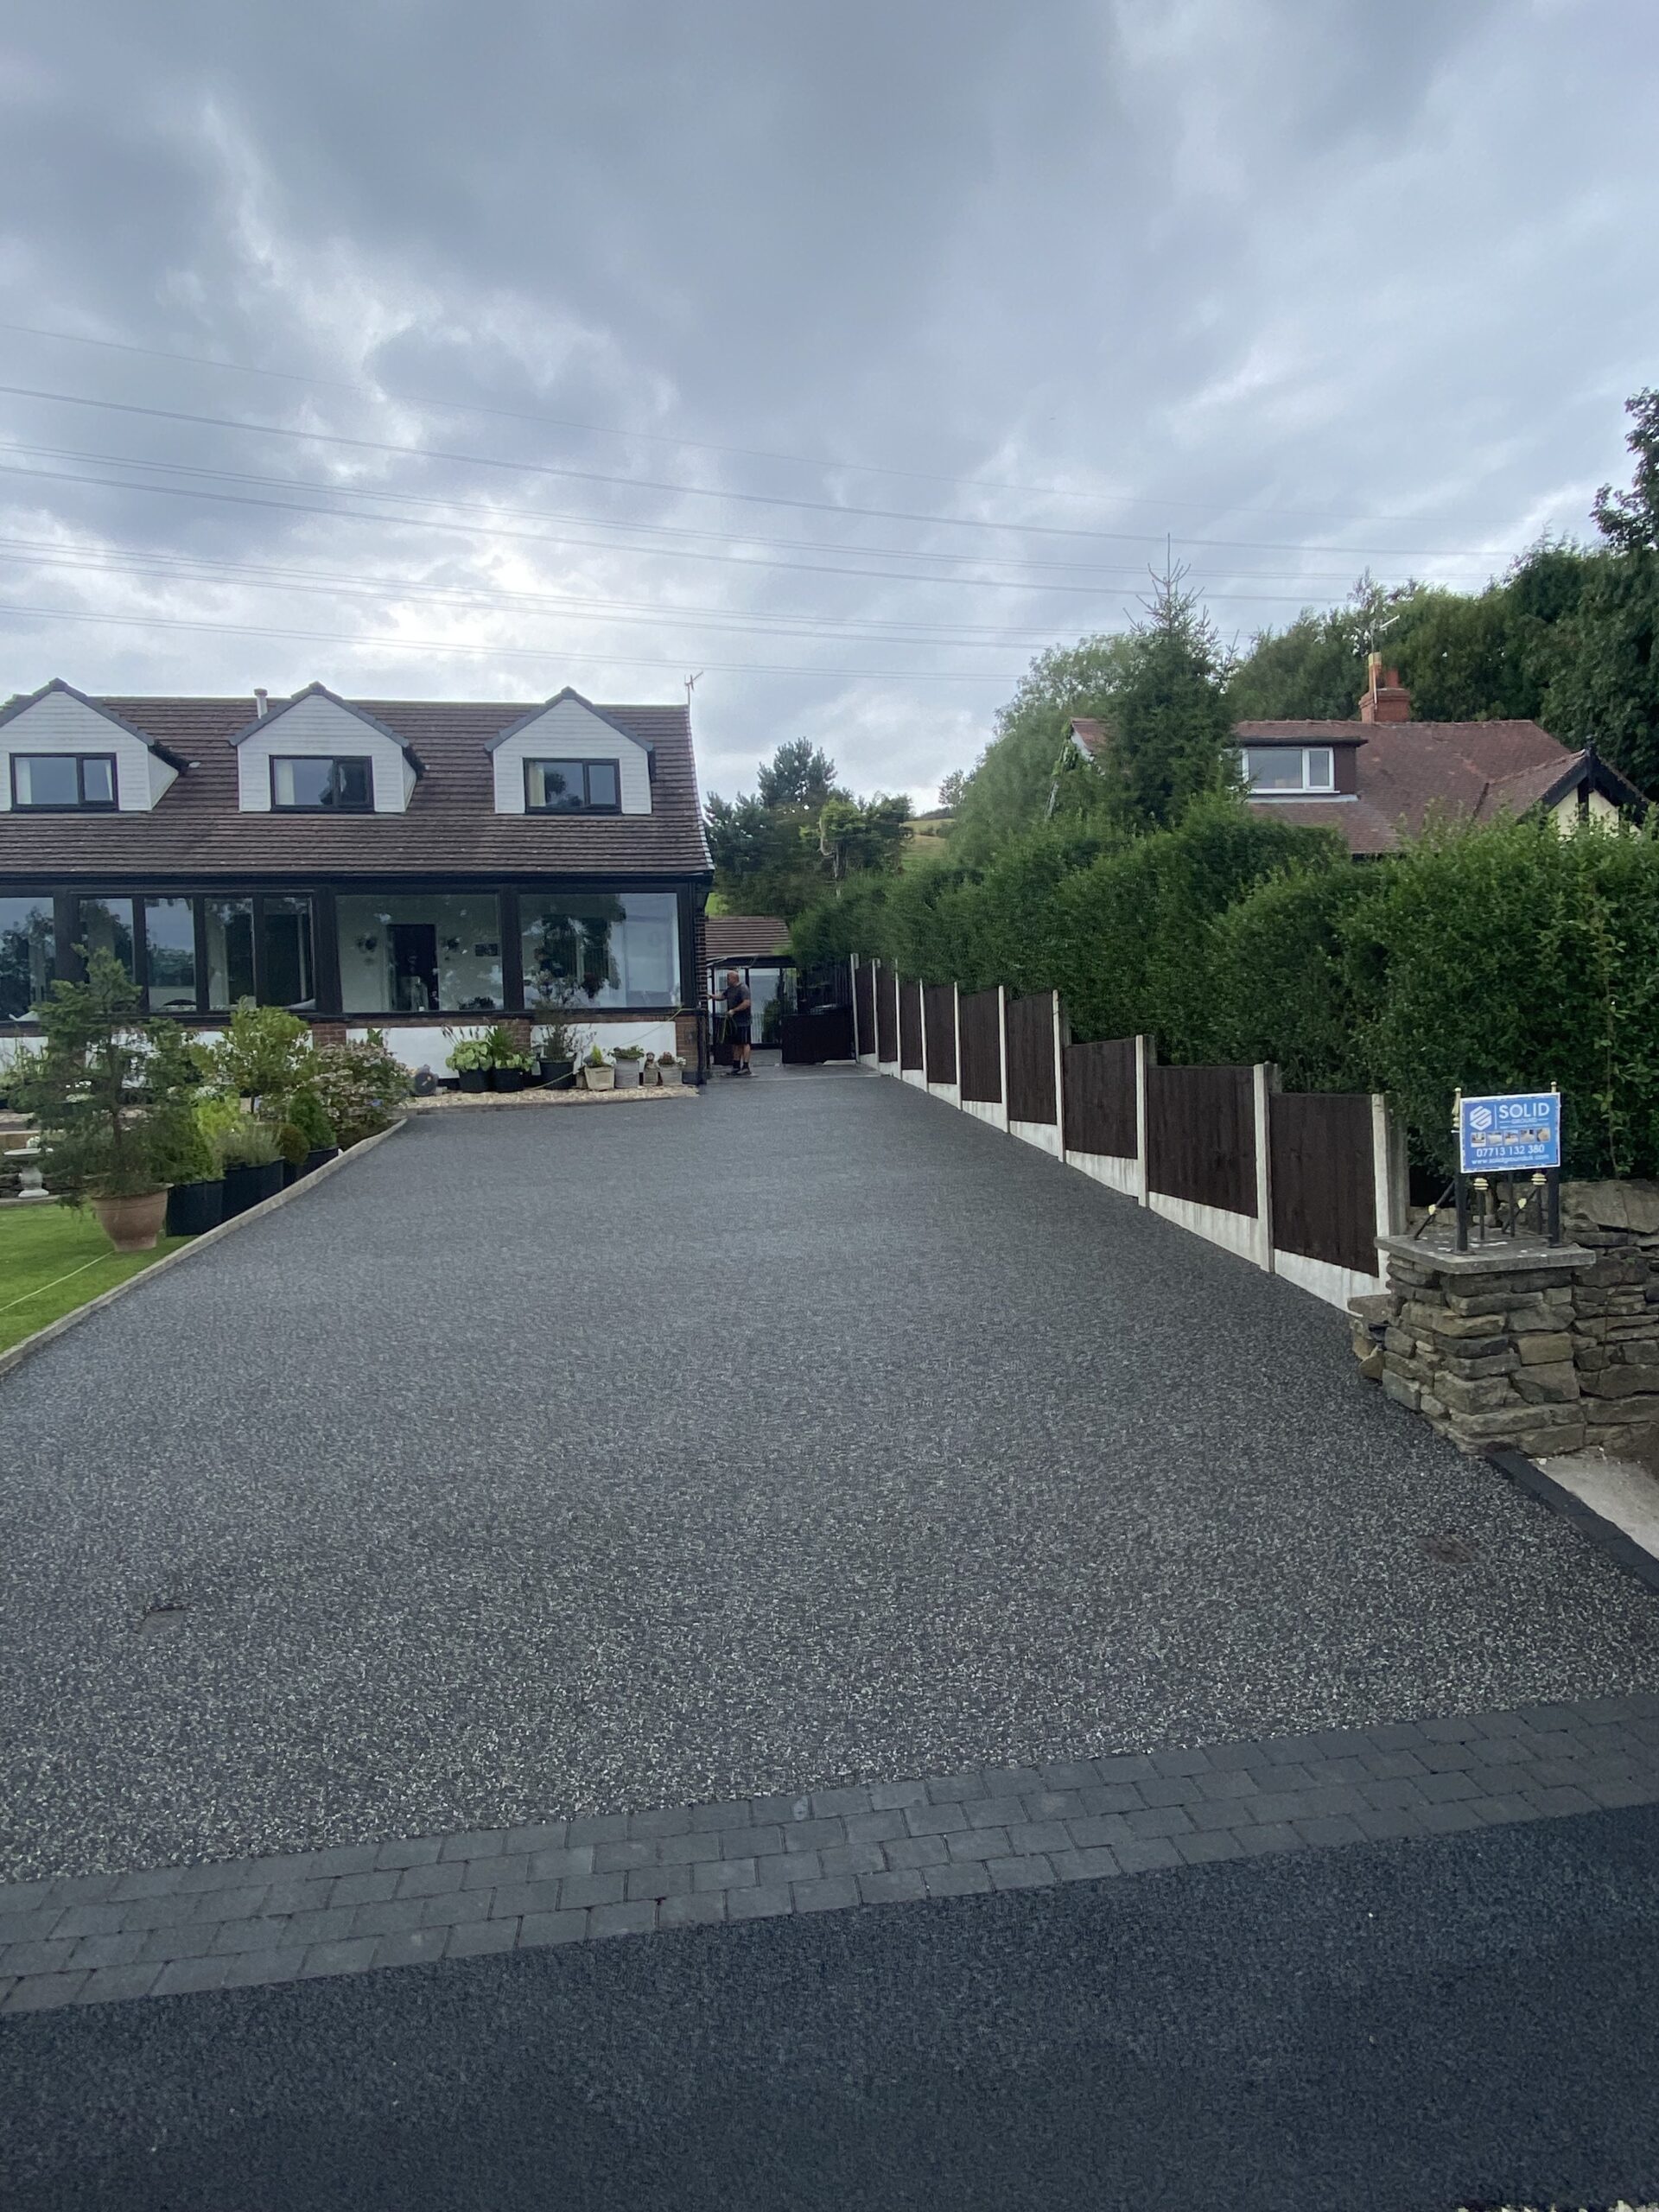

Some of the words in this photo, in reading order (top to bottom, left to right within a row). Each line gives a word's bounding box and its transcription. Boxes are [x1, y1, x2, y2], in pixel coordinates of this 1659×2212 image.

[1498, 1103, 1550, 1119] SOLID
[1476, 1147, 1506, 1158] 07713
[1509, 1145, 1525, 1155] 132
[1528, 1143, 1545, 1154] 380
